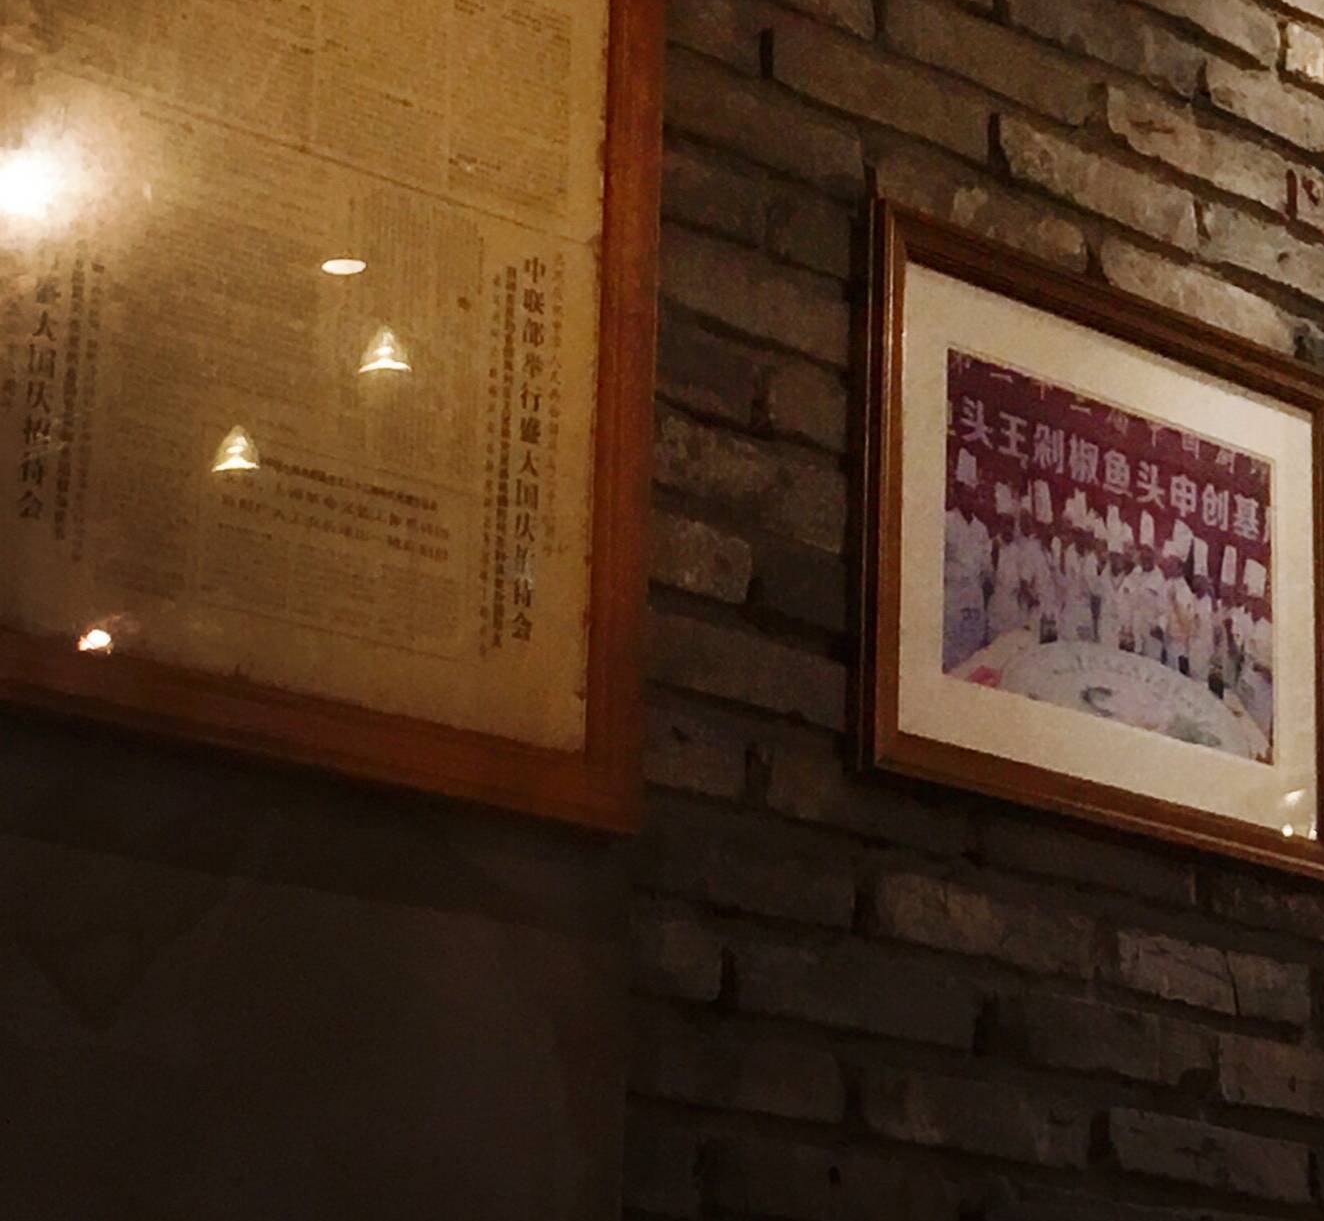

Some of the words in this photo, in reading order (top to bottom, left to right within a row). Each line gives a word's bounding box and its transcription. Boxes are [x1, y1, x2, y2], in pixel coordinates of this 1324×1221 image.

[947, 394, 1272, 545] 头王剁椒鱼头申创基
